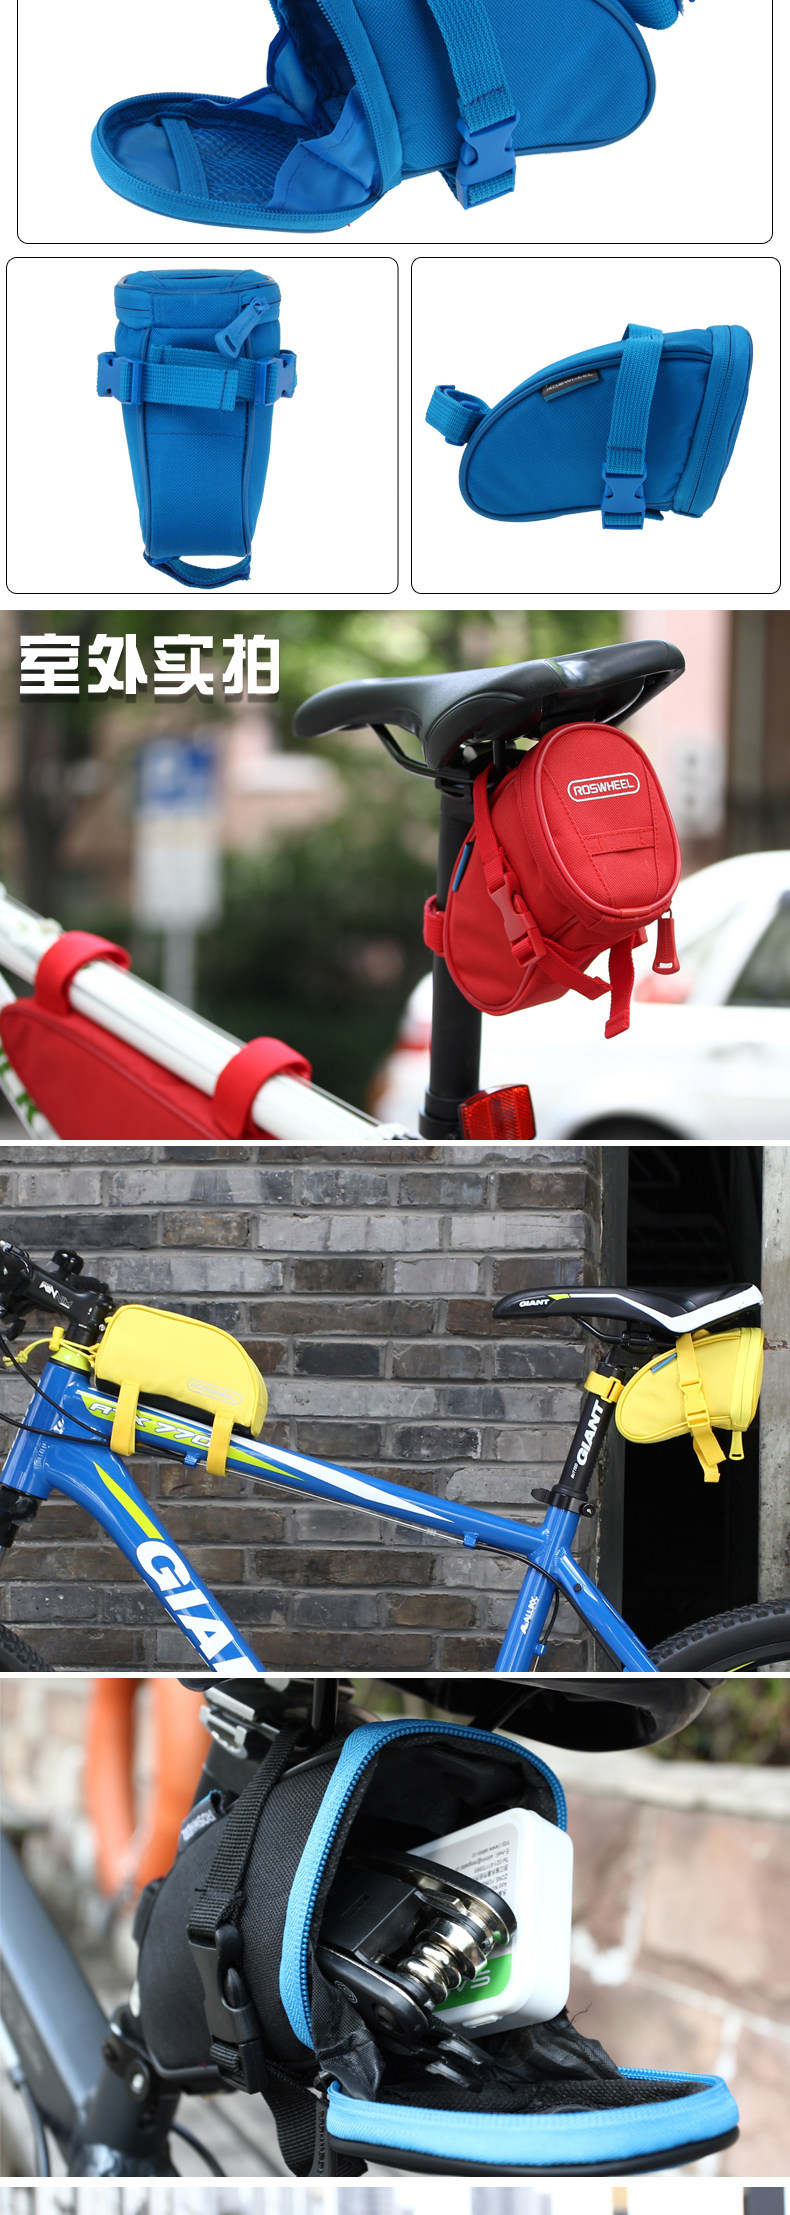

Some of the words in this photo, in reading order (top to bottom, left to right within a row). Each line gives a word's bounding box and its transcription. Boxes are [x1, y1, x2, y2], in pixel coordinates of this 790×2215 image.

[573, 778, 635, 796] ROSWHEEL
[519, 1299, 550, 1308] GIANT
[576, 1399, 604, 1466] GIANT
